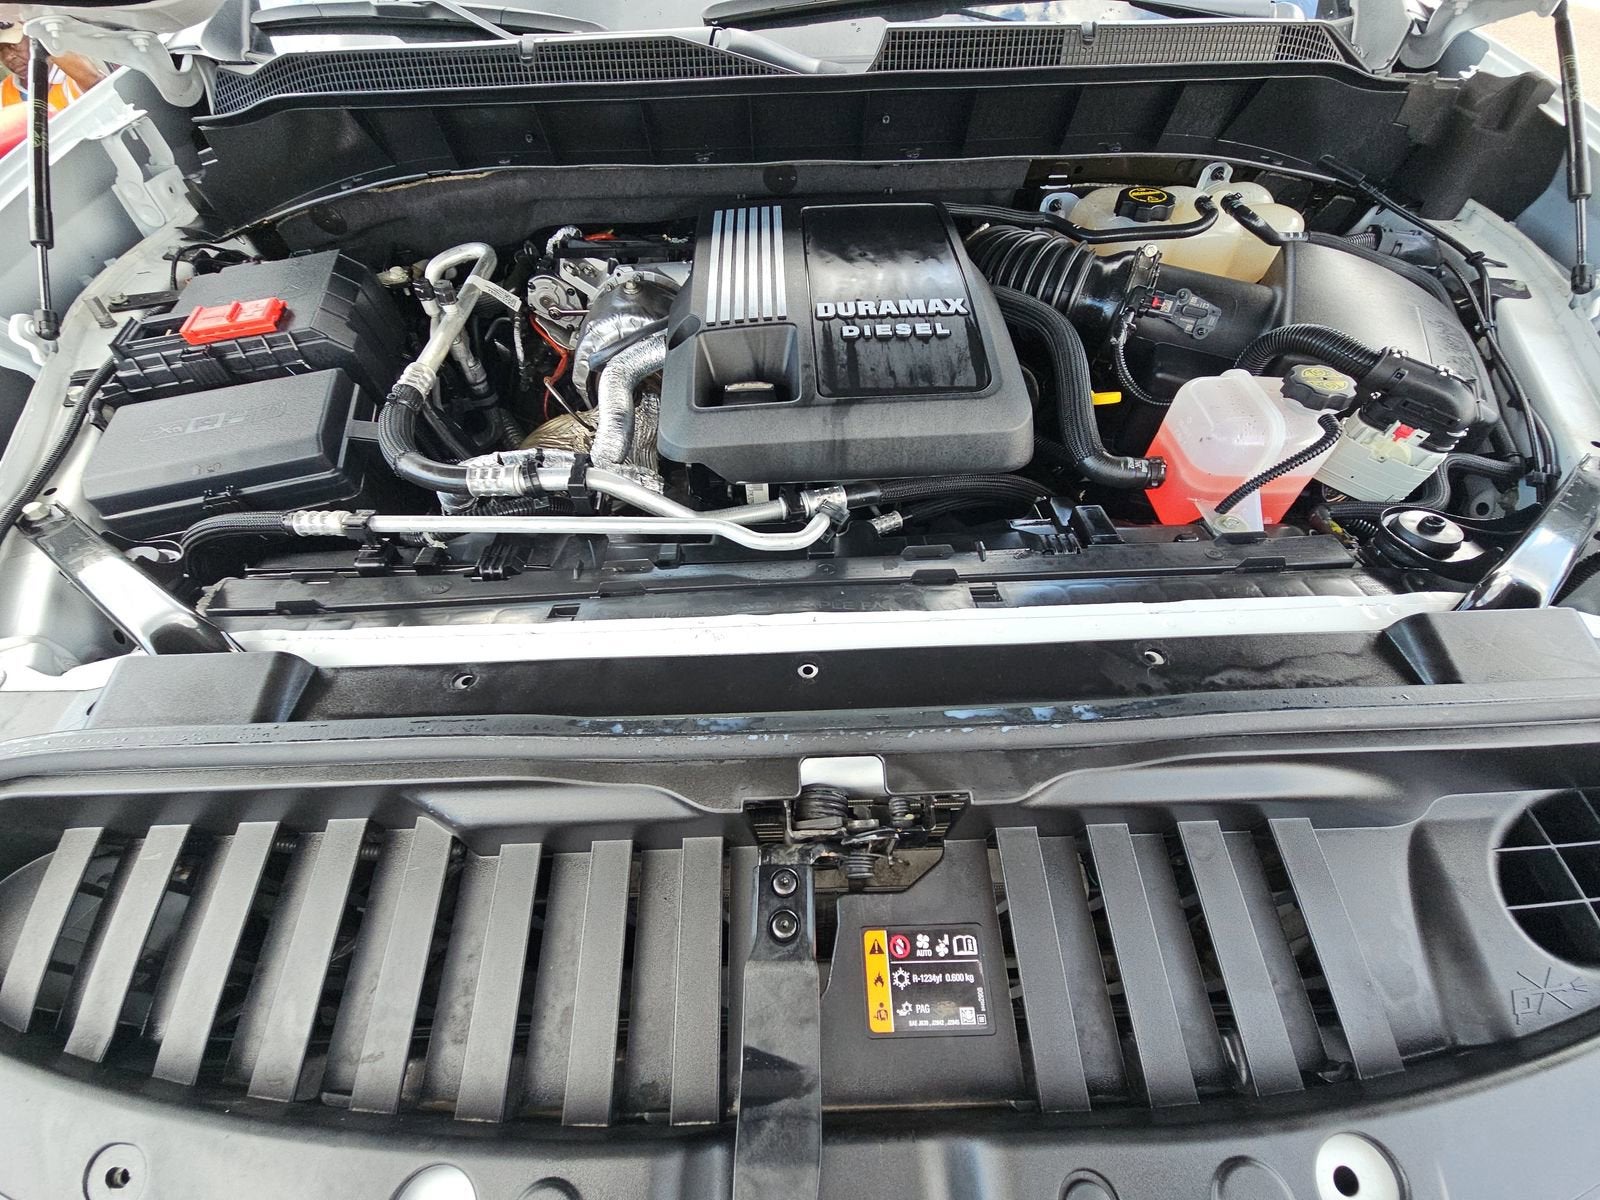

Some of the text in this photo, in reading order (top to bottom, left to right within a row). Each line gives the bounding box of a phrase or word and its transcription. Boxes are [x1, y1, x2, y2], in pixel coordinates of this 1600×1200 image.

[816, 299, 969, 319] DURAMAX
[842, 323, 950, 337] DIESEL
[916, 949, 932, 957] AUTO
[912, 973, 974, 984] R-1234yf 0.600 kg
[915, 1004, 930, 1014] PAG
